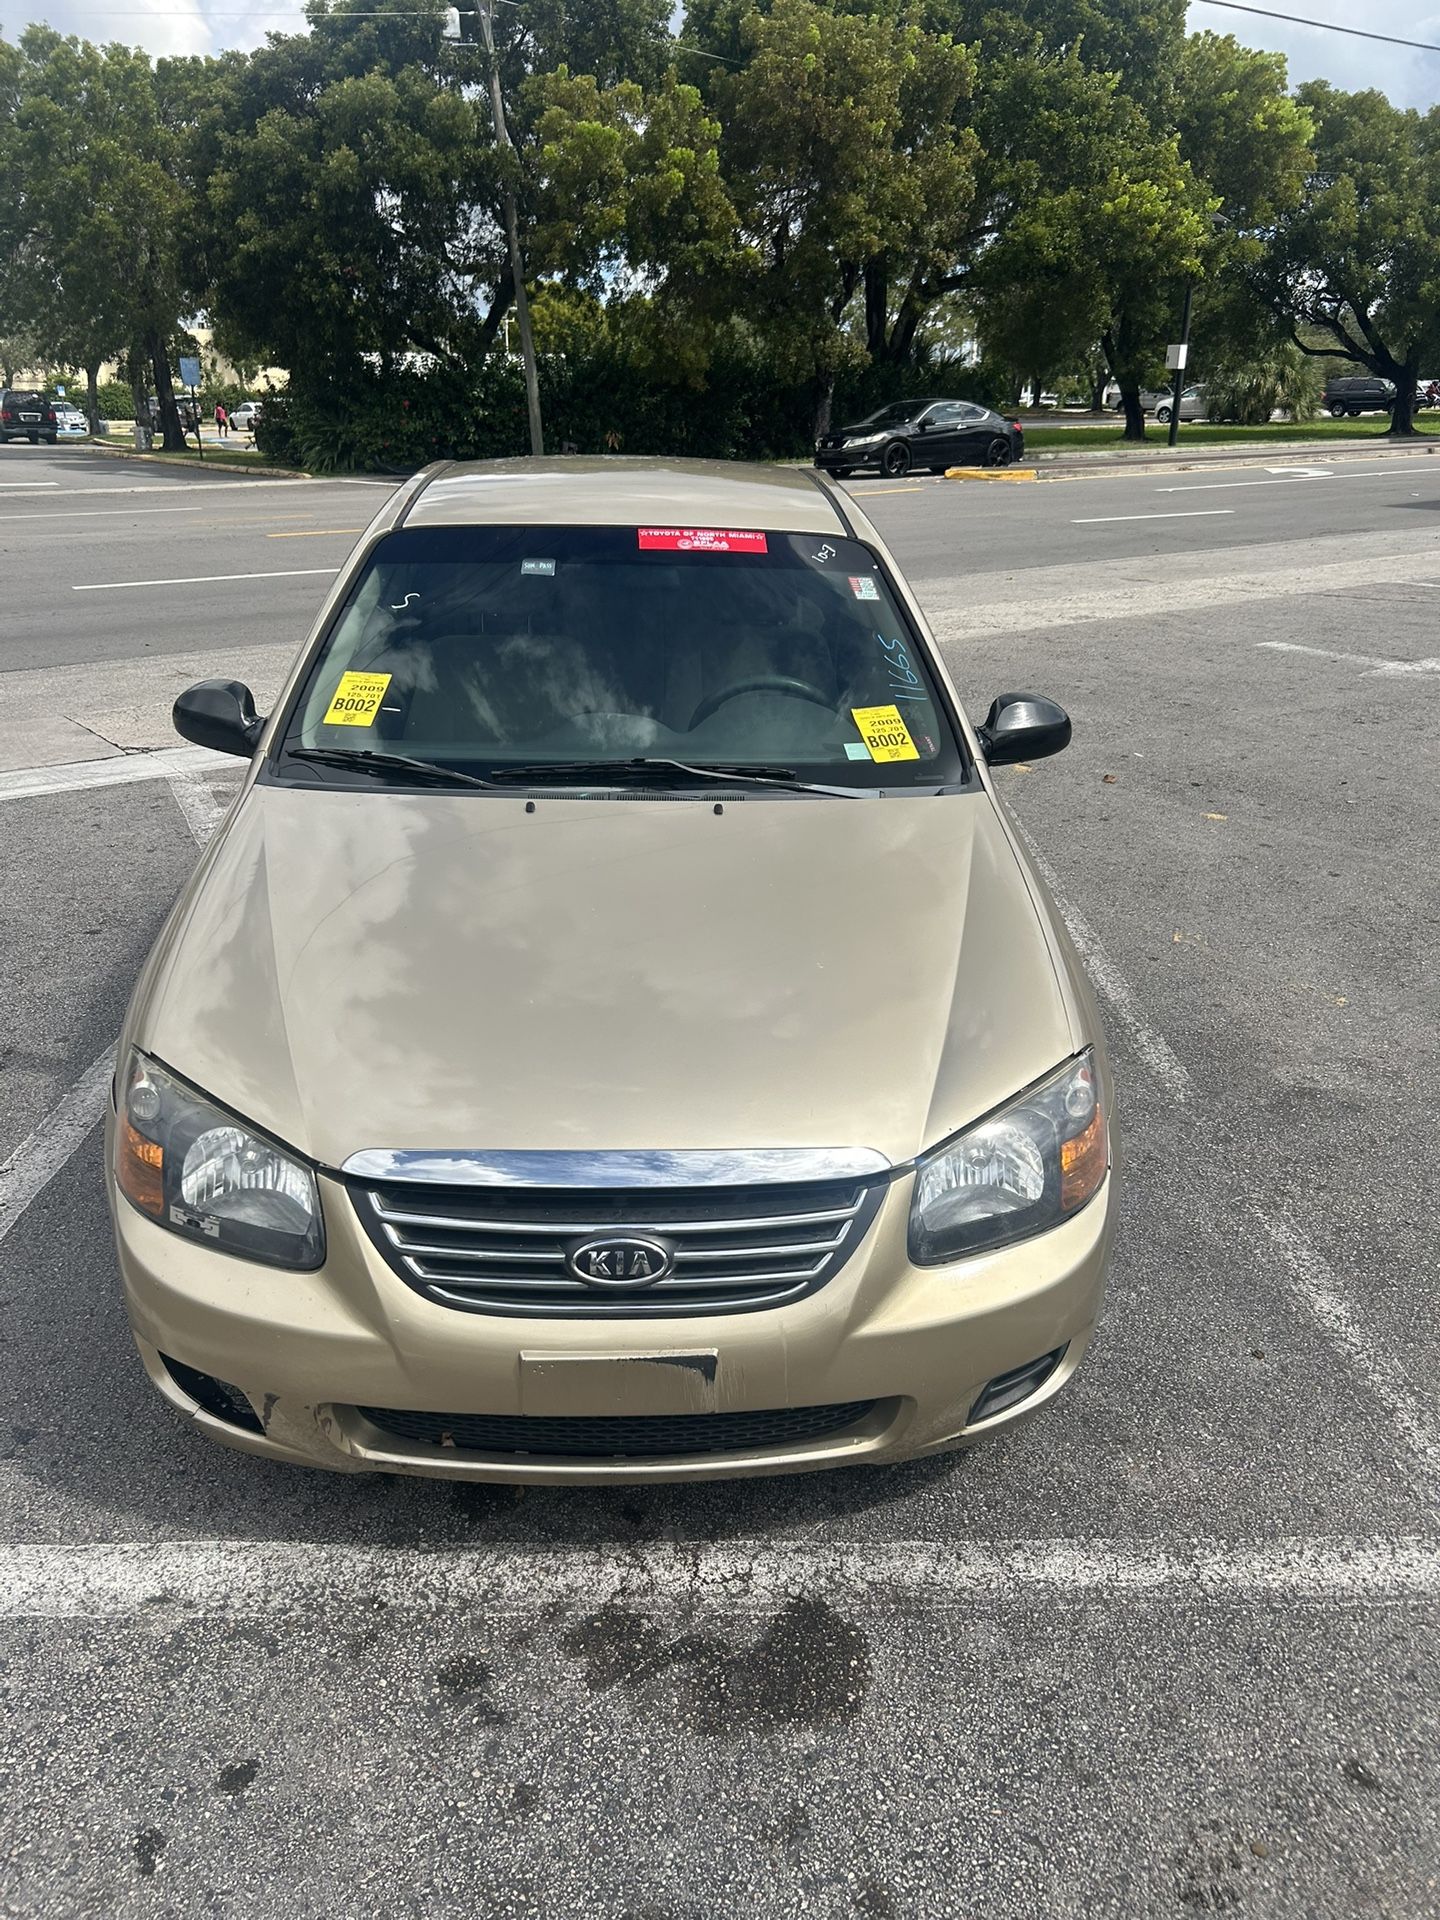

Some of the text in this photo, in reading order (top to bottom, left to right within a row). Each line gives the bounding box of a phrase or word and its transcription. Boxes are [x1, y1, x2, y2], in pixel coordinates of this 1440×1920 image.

[729, 532, 756, 540] MIAMI
[351, 684, 385, 692] 2009
[333, 697, 376, 712] B002
[869, 718, 901, 727] 2009
[867, 732, 909, 748] B002
[588, 1250, 652, 1276] KIA
